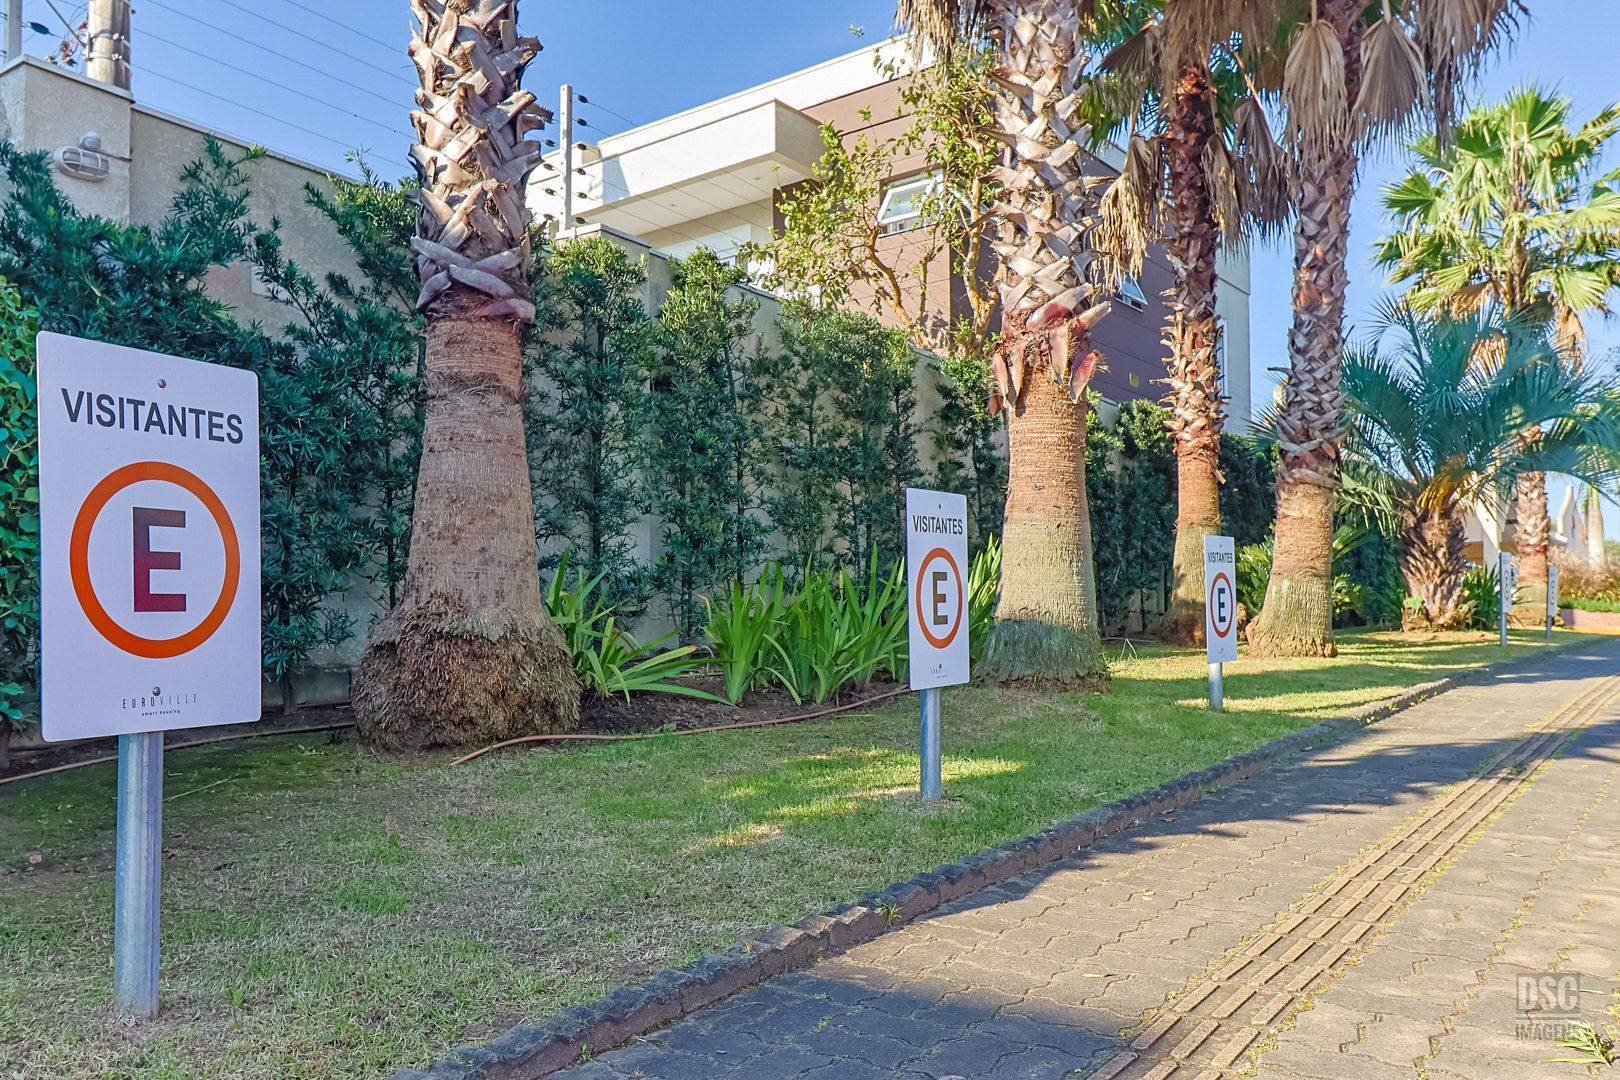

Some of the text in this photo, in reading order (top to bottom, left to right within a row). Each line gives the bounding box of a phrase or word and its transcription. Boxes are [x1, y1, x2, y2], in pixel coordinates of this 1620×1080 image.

[60, 387, 244, 445] VISITANTES
[912, 514, 963, 535] VISITANTES
[132, 506, 187, 613] E
[1207, 551, 1233, 564] VISITANTES
[932, 571, 948, 626] E
[1217, 587, 1226, 623] E
[122, 693, 198, 709] EUROVILLE
